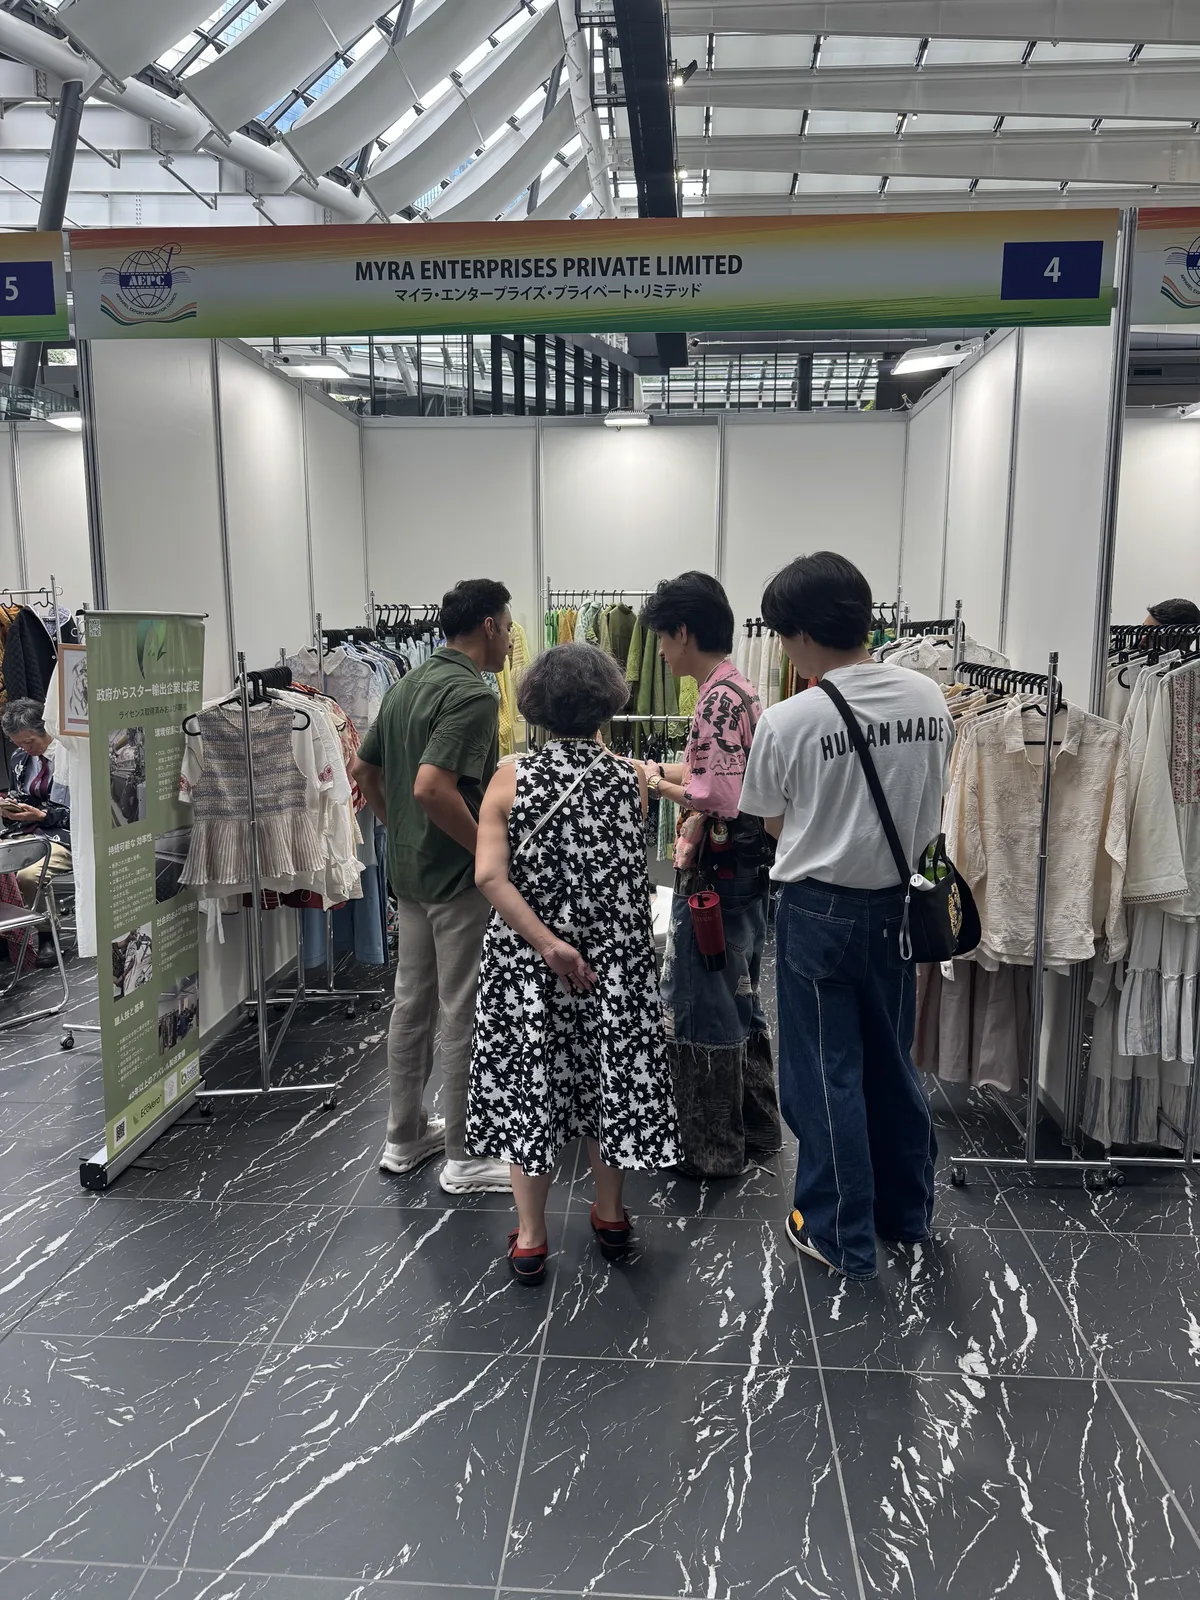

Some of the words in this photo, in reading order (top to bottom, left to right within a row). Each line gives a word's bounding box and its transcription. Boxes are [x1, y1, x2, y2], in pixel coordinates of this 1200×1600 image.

[356, 261, 415, 281] MYRA
[420, 258, 557, 280] ENTERPRISES
[563, 257, 650, 277] PRIVATE
[656, 255, 743, 275] LIMITED
[1043, 256, 1062, 283] 4
[5, 276, 19, 301] 5
[128, 275, 165, 286] AEPC
[116, 293, 129, 309] APPAREL
[129, 307, 145, 316] EXPORT
[145, 306, 167, 316] PROMOTION
[166, 292, 178, 307] COUNCIL
[394, 283, 703, 303] マイラ・エンタープライズ・プライベート・リミテッド
[96, 680, 200, 701] 政府からスター輸出企業に認定
[896, 717, 944, 745] MADE
